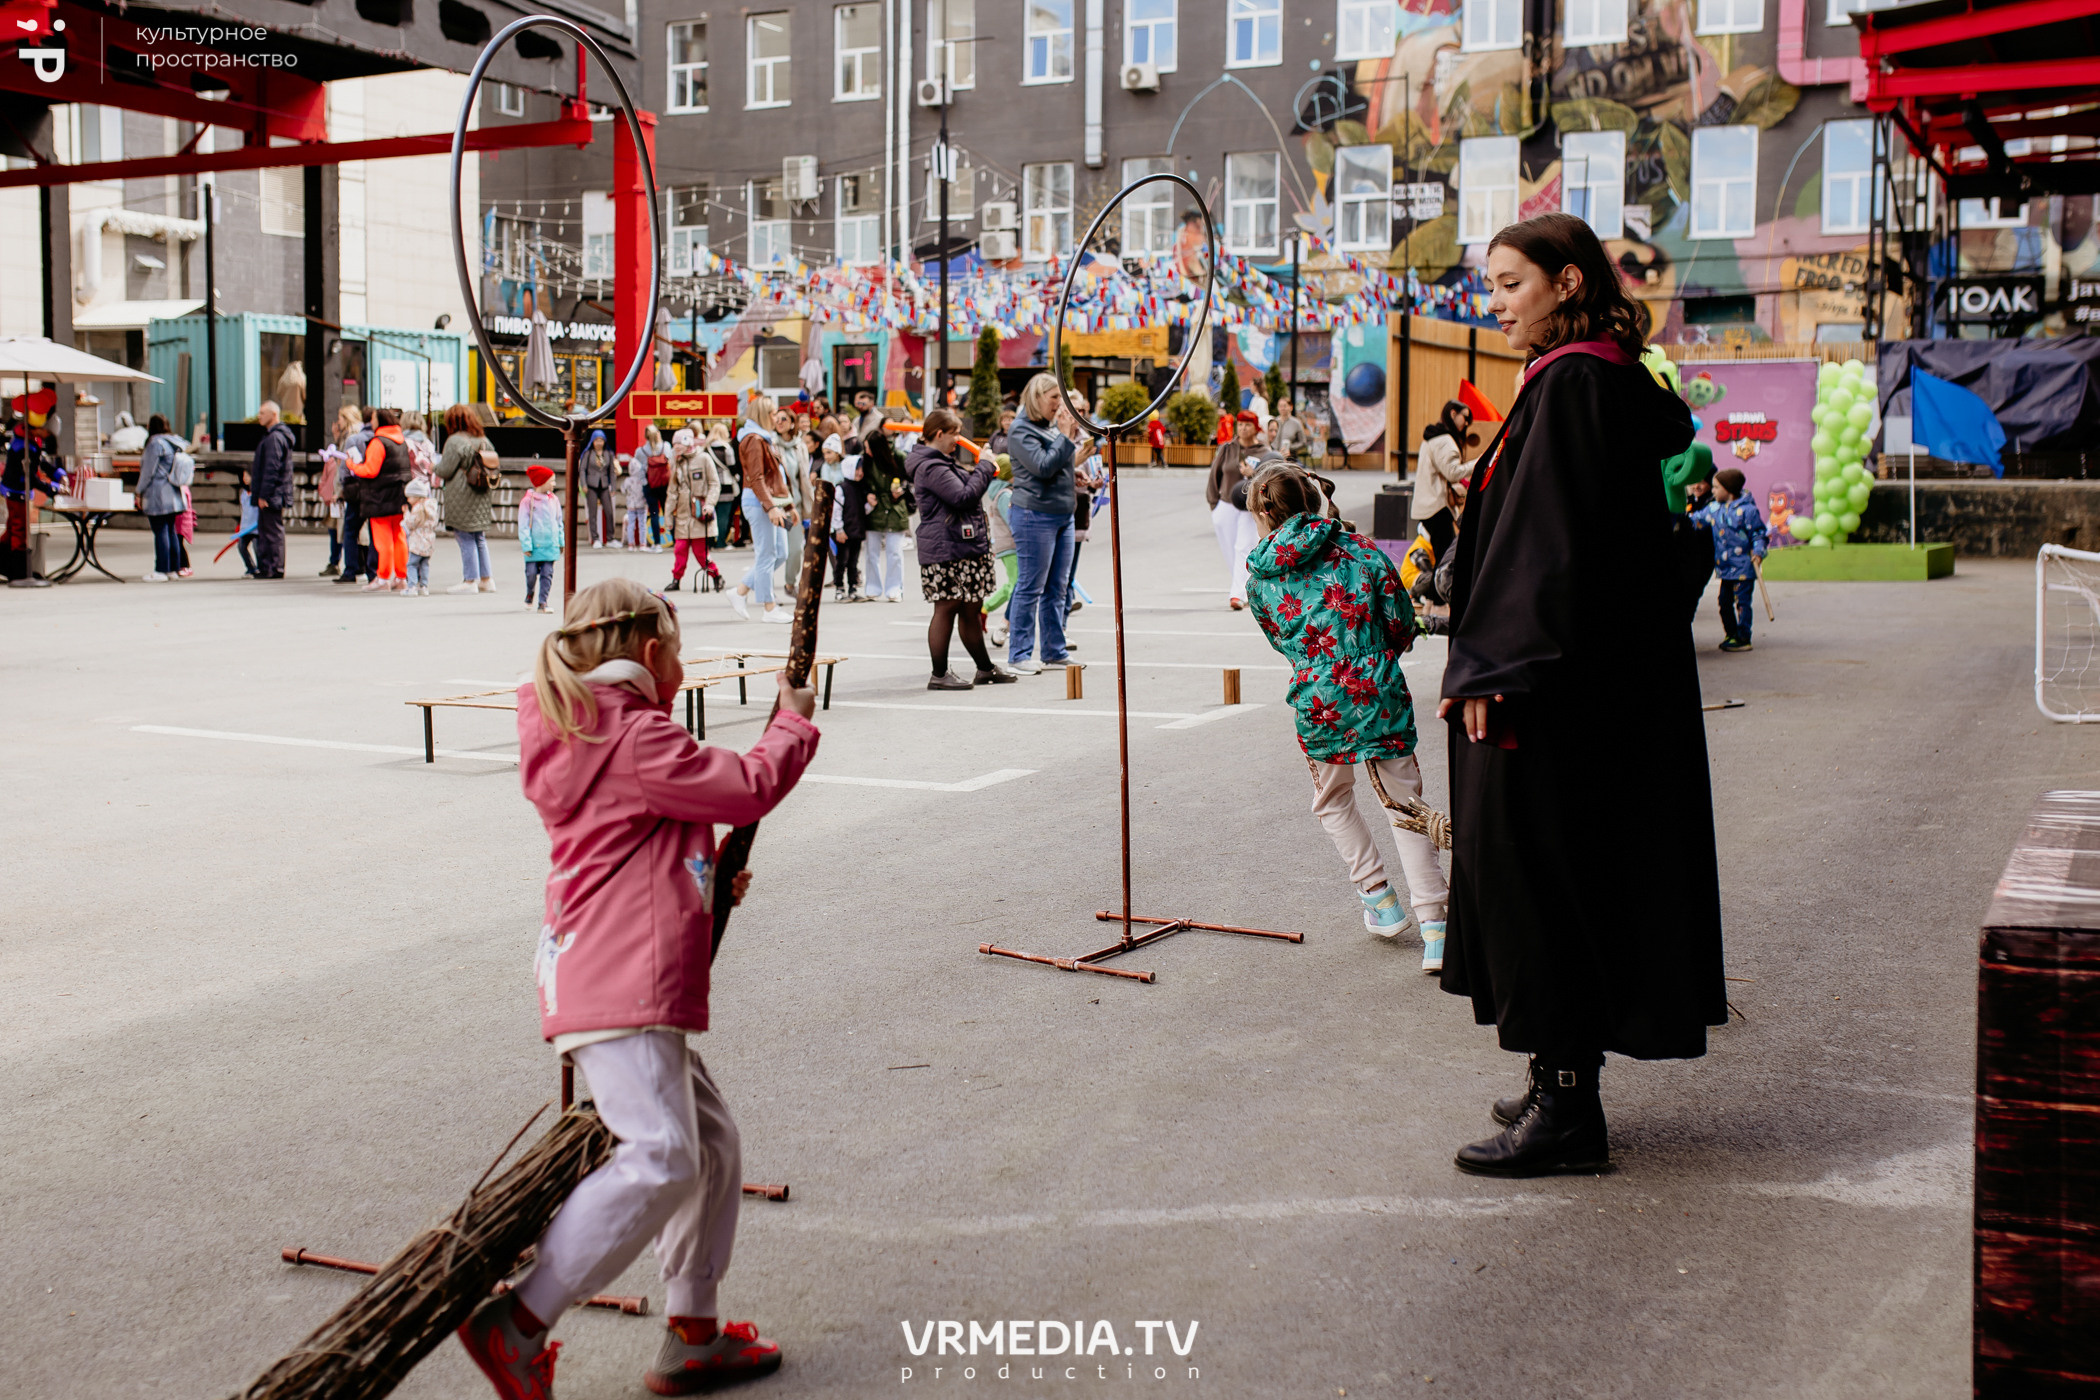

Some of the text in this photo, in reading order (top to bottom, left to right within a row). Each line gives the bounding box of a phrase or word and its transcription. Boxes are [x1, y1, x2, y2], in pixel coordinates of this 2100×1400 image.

[494, 315, 533, 336] ПИВО
[545, 320, 565, 340] ДА
[569, 321, 616, 342] ЗАКУСК
[1715, 420, 1778, 443] STARS
